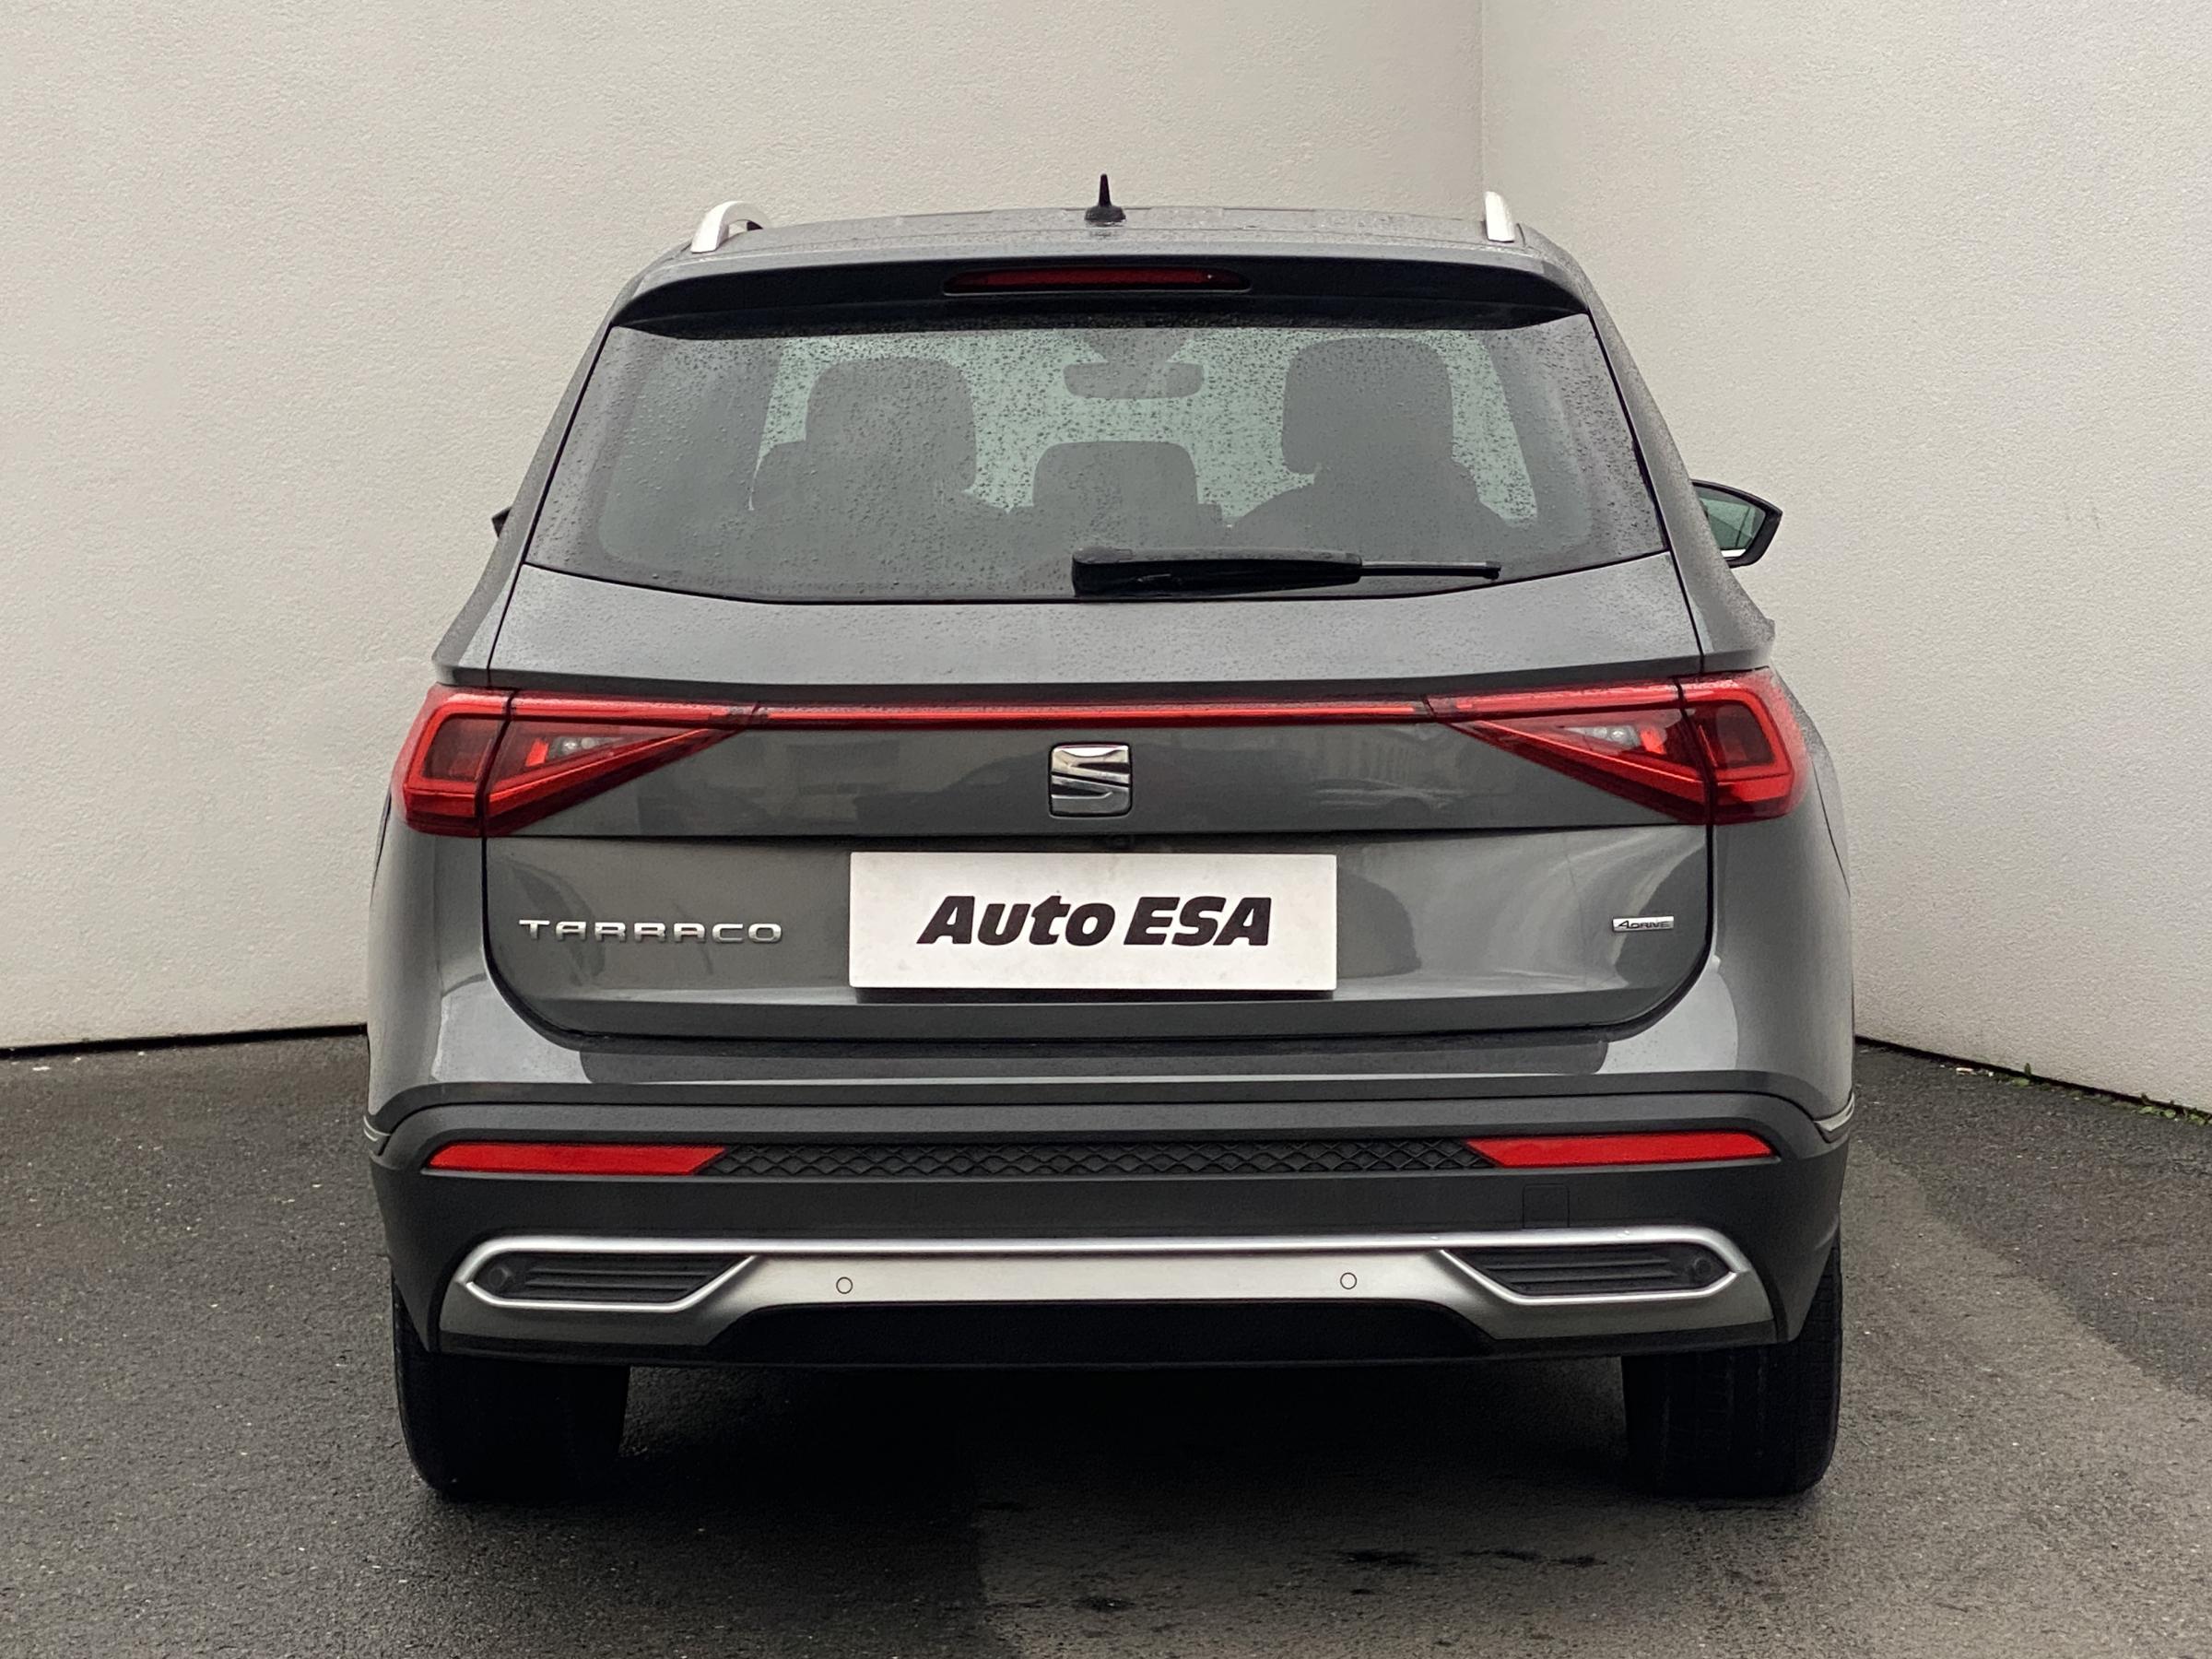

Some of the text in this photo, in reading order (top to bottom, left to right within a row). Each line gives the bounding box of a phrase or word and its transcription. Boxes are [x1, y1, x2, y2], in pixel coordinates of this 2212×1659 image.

[519, 919, 782, 944] TARRACO
[916, 895, 1272, 947] Auto ESA
